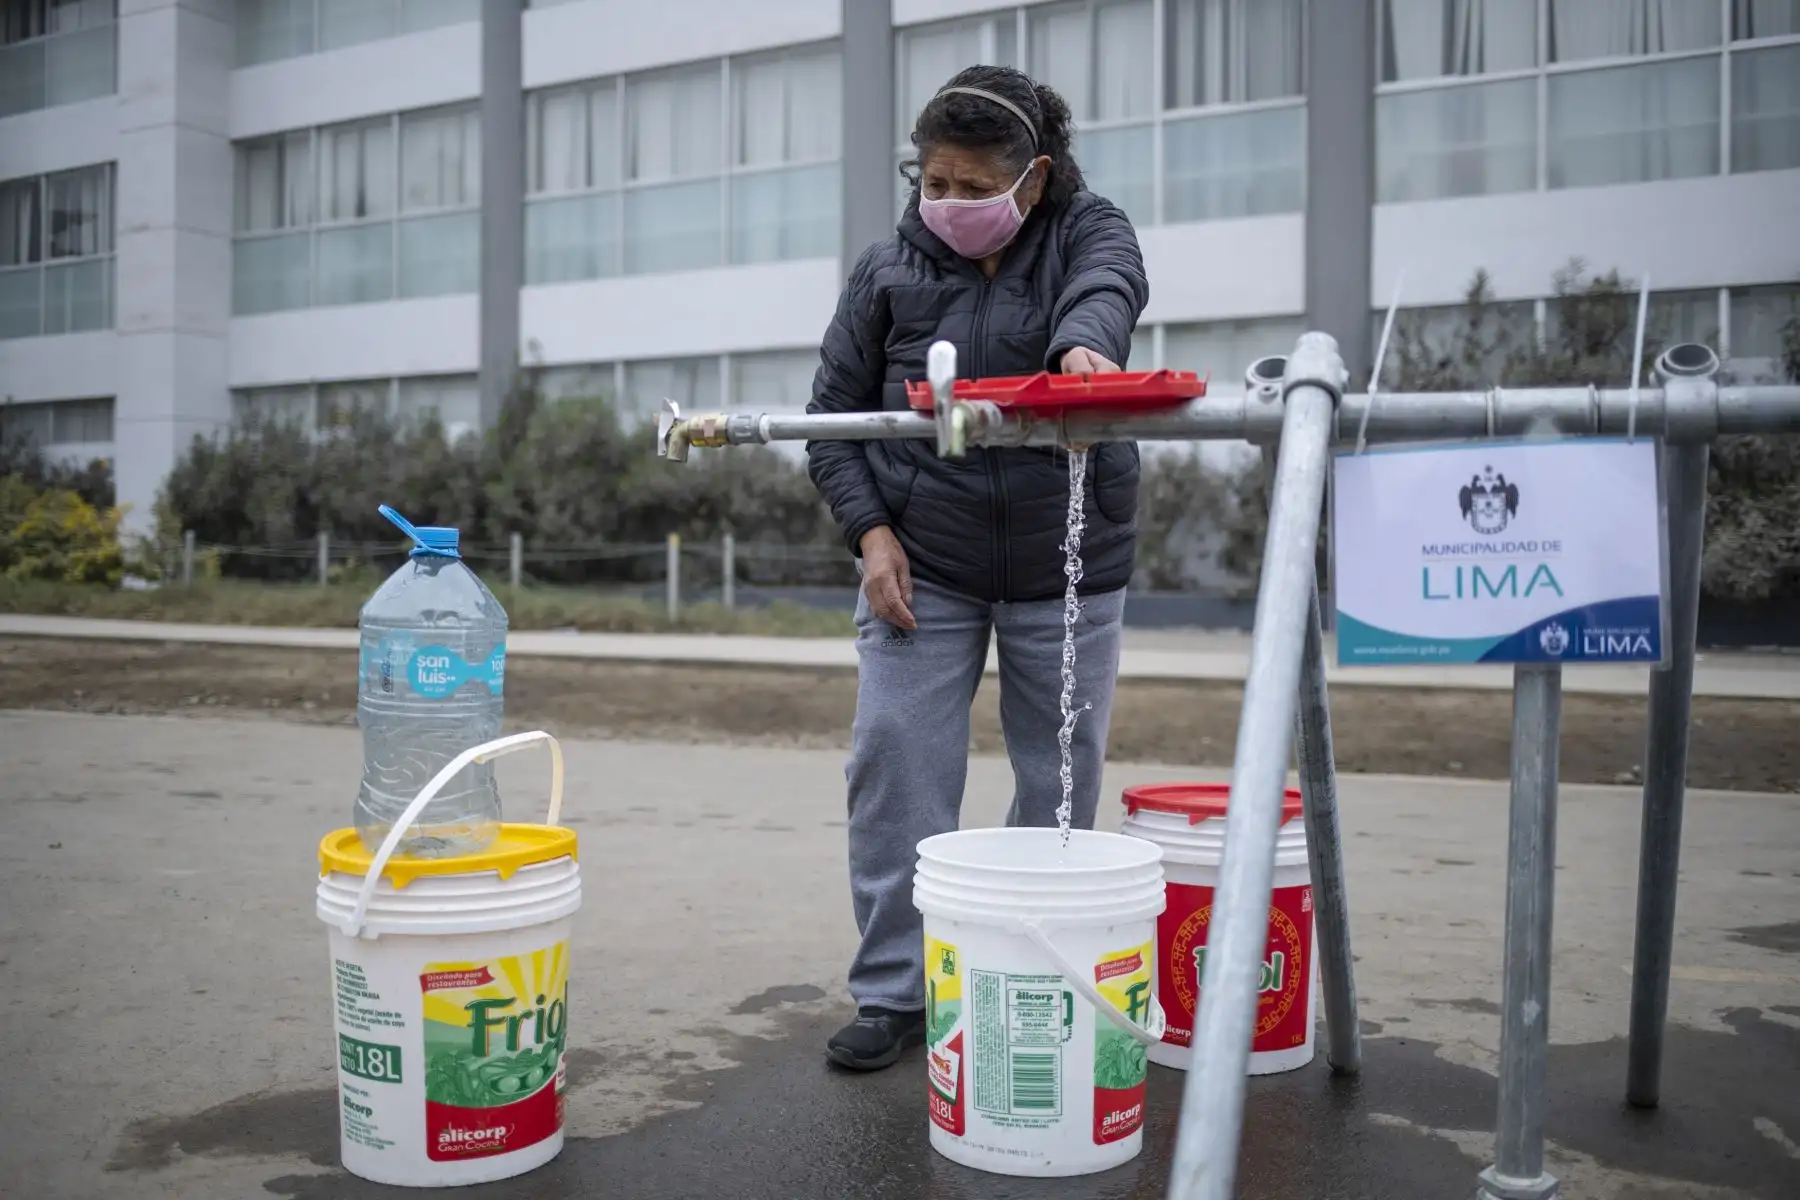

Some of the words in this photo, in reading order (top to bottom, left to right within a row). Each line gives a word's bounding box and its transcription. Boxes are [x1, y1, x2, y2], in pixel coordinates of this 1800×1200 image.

[1422, 540, 1538, 556] MUNICIPALIDAD
[1542, 540, 1561, 552] DE
[1422, 563, 1564, 600] LIMA
[1583, 634, 1652, 654] LIMA
[417, 655, 450, 669] san
[418, 668, 447, 684] luis
[427, 972, 463, 982] Diseñado
[463, 971, 482, 981] para
[428, 979, 477, 989] restaurantes
[1016, 991, 1054, 1002] alicorp
[1167, 1024, 1192, 1037] licorp
[356, 1046, 400, 1079] 18L
[935, 1098, 955, 1122] 18L
[1103, 1104, 1140, 1126] alicorp
[438, 1125, 507, 1143] alicorp
[465, 1140, 500, 1150] Cocina
